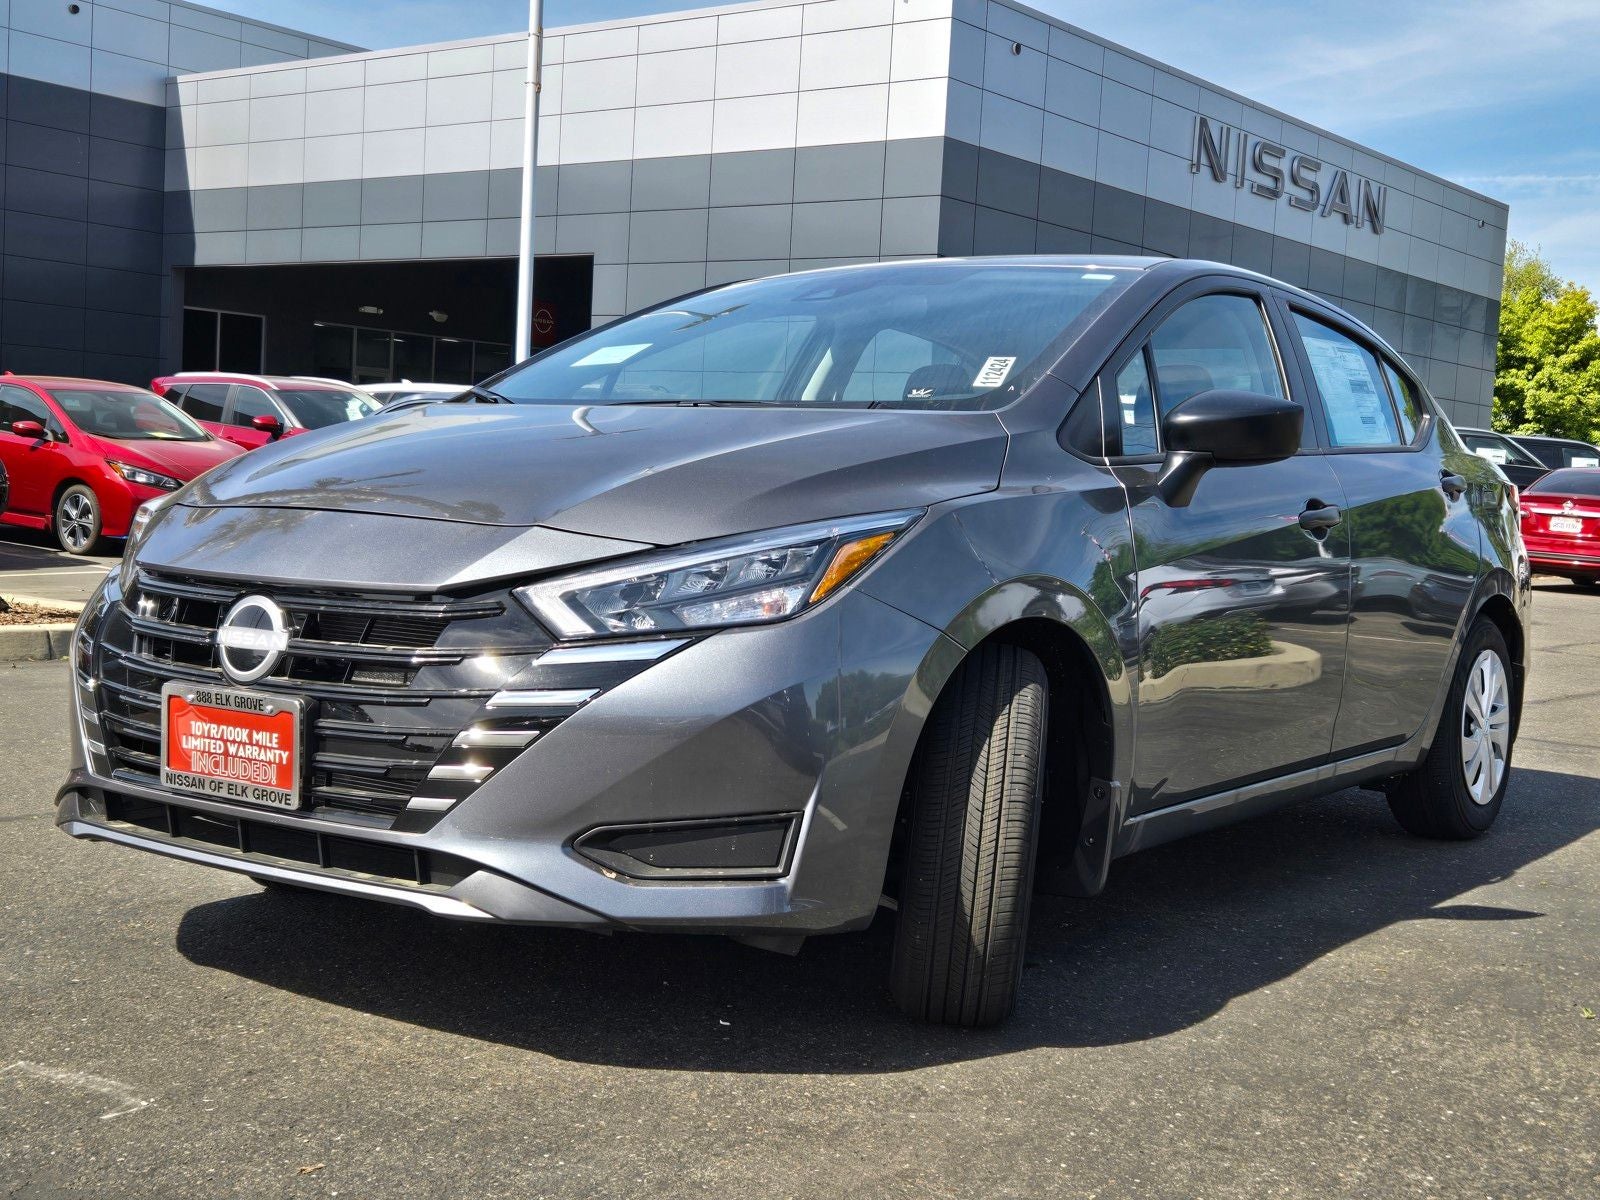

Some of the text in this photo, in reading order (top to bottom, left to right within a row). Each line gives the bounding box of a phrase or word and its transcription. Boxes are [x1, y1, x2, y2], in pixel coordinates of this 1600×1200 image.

[1190, 115, 1388, 235] NISSAN
[217, 628, 288, 650] NISSAN
[215, 692, 232, 706] ELK
[234, 695, 264, 711] GROVE
[190, 720, 279, 748] 10YR/100K MILE
[182, 735, 289, 765] LIMITED WARRANTY
[191, 751, 277, 785] INCLUDED!
[165, 772, 292, 806] NISSAN OF ELK GROVE
